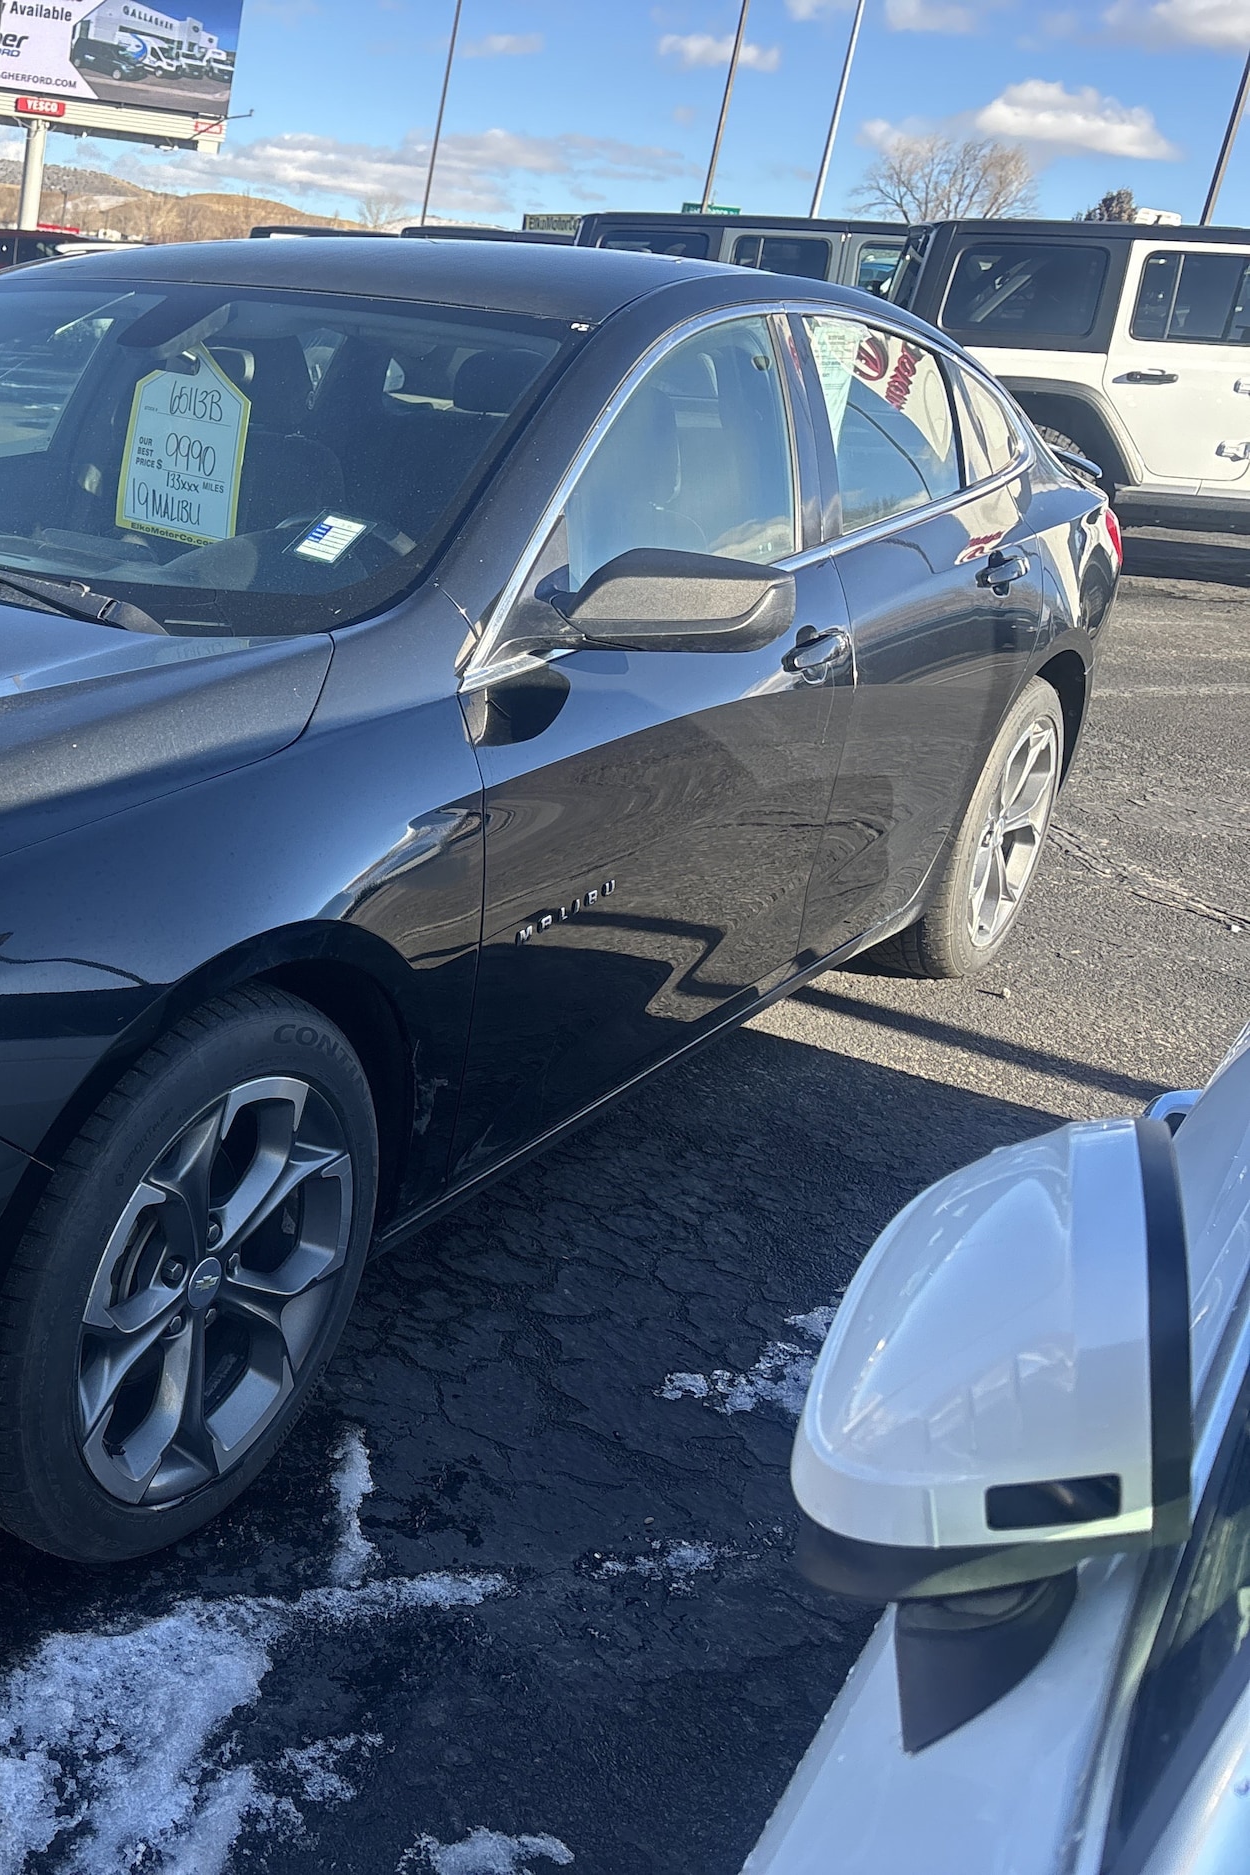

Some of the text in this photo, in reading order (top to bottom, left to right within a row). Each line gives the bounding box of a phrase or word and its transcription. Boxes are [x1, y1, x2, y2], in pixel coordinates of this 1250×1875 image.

[9, 3, 73, 21] Available
[26, 99, 58, 113] YESCO
[169, 380, 223, 422] 65113B
[137, 446, 154, 457] BEST
[139, 436, 153, 446] OUR
[135, 457, 155, 469] PRICE
[165, 433, 216, 476] 9990
[202, 481, 225, 494] MILES
[132, 478, 200, 526] 19 MALIBU
[130, 522, 214, 547] ElkoMotorCo.co
[515, 879, 616, 946] MALIBU
